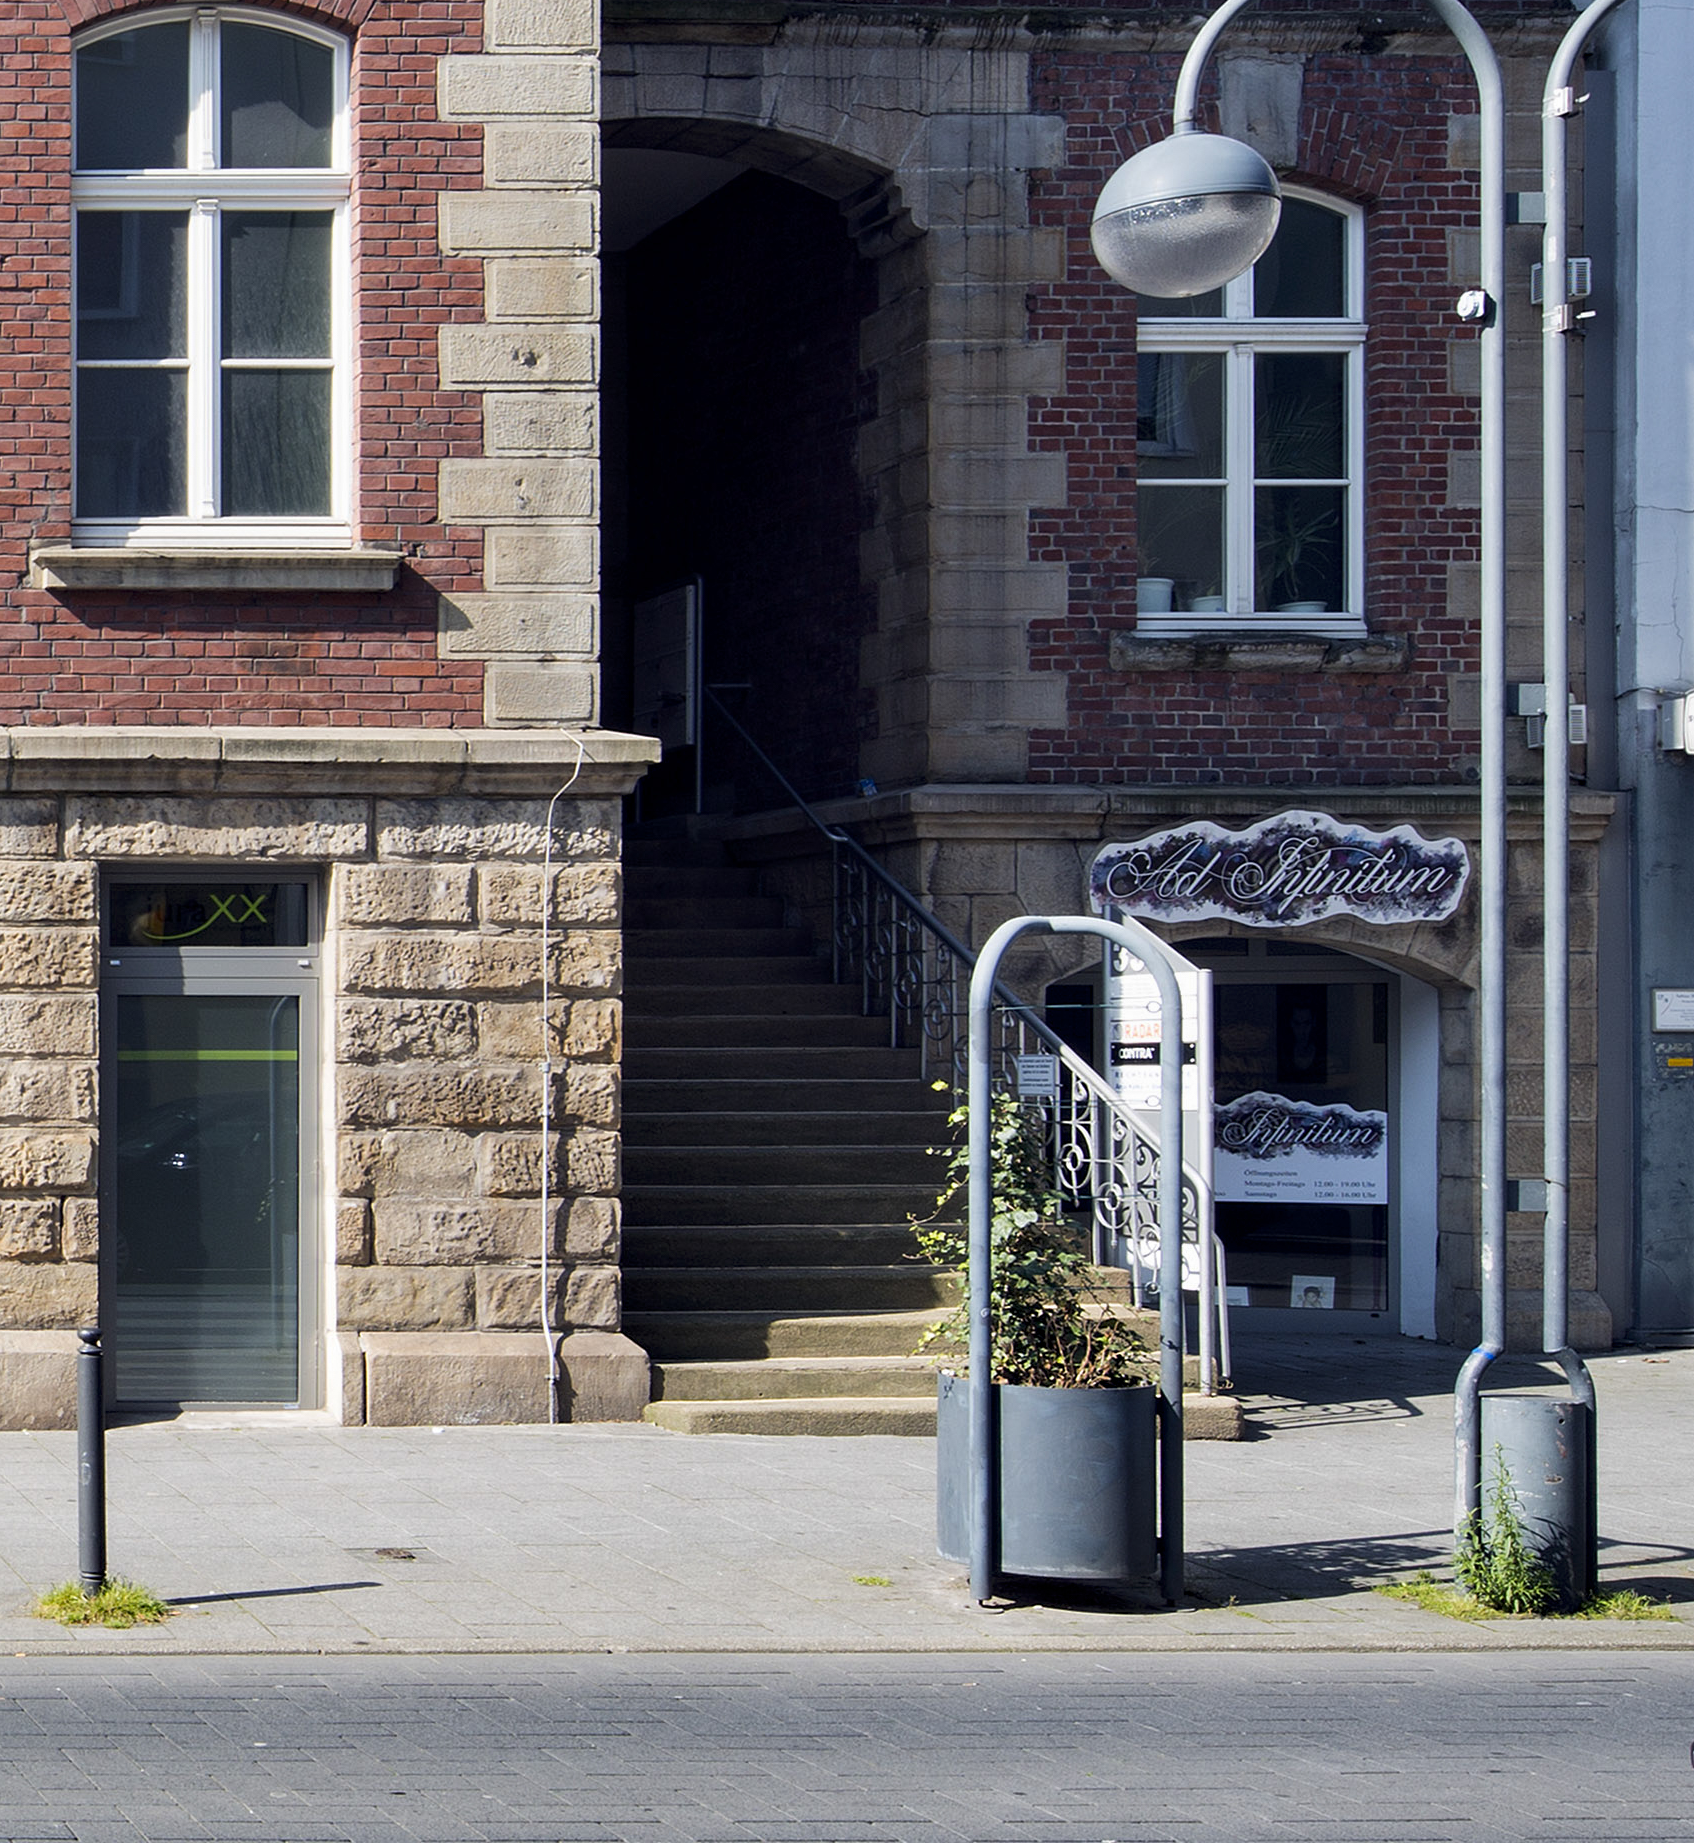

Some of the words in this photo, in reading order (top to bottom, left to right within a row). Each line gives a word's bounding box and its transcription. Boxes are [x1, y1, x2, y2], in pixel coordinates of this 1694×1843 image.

[1106, 837, 1222, 903] Ad
[1222, 836, 1455, 915] Infinitum
[1222, 1108, 1378, 1155] Infinitum
[1243, 1168, 1298, 1177] Öffnungszeiten
[1314, 1180, 1334, 1188] 12.00
[1244, 1190, 1277, 1199] Samstags
[1314, 1190, 1334, 1198] 12.00
[1362, 1191, 1377, 1199] Uhr
